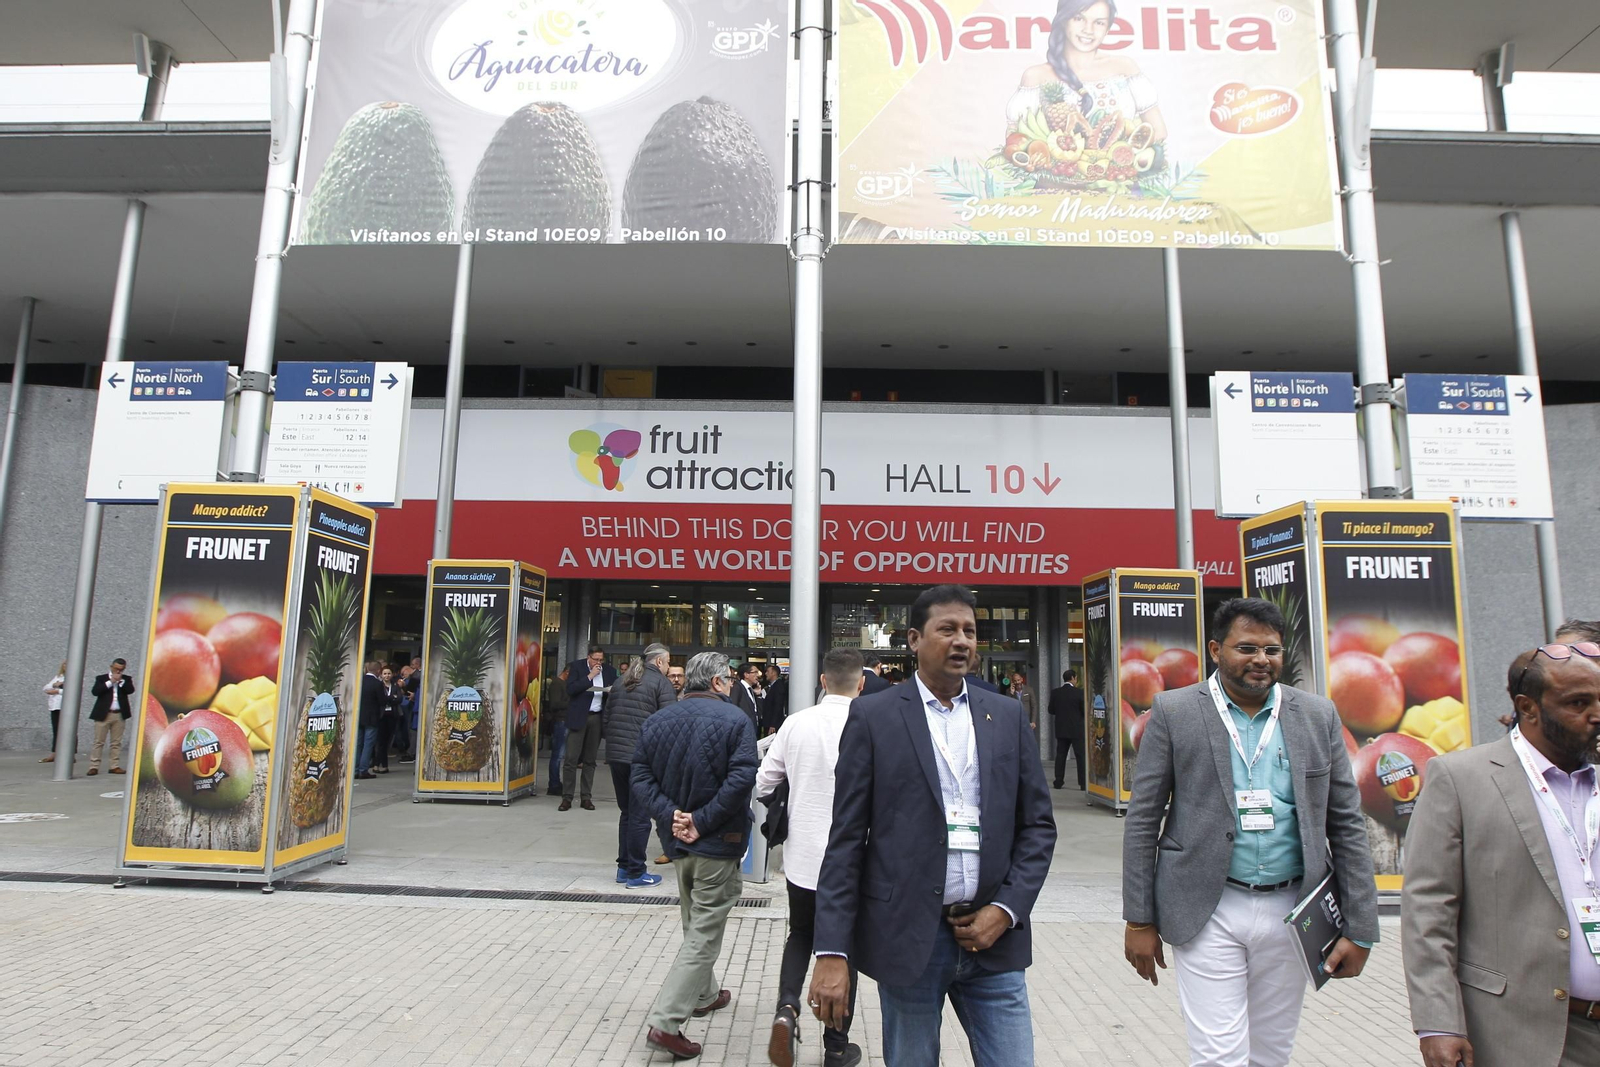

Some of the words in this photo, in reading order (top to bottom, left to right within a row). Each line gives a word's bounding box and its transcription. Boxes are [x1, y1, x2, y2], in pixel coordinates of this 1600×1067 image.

[858, 0, 1277, 66] Marelita
[449, 40, 648, 92] Aguacatera
[518, 81, 542, 91] DEL
[550, 81, 578, 91] SUR
[960, 196, 1042, 222] Somos
[1051, 196, 1212, 224] Maduradores
[351, 228, 431, 243] Visítanos
[436, 231, 458, 243] en
[464, 228, 480, 243] el
[485, 228, 538, 243] Stand
[544, 228, 601, 242] 10E09
[621, 226, 700, 242] Pabellón
[705, 227, 727, 242] 10
[897, 226, 981, 242] Visítanos
[986, 230, 1009, 242] en
[1015, 227, 1031, 242] el
[1037, 228, 1090, 243] Stand
[1097, 229, 1154, 244] 10E09
[1173, 229, 1256, 245] Pabellón
[1259, 231, 1279, 246] 10
[135, 373, 167, 383] Norte
[174, 372, 203, 383] North
[312, 374, 332, 384] Sur
[339, 373, 371, 384] South
[1254, 384, 1289, 394] Norte
[1296, 384, 1329, 395] North
[1442, 387, 1465, 397] Sur
[1471, 387, 1505, 398] South
[650, 424, 722, 454] fruit
[646, 460, 836, 491] attractin
[886, 464, 971, 494] HALL
[985, 464, 1025, 495] 10
[193, 503, 229, 519] Mango
[230, 505, 269, 518] addict?
[318, 512, 348, 531] Pineapples
[347, 521, 366, 537] addict?
[582, 516, 680, 538] BEHIND
[688, 517, 743, 539] THIS
[753, 518, 839, 541] DOR
[847, 519, 907, 542] YOU
[916, 520, 975, 543] WILL
[983, 521, 1046, 544] FIND
[1342, 522, 1352, 534] Ti
[1353, 522, 1382, 537] piace
[1383, 522, 1391, 534] il
[1391, 522, 1435, 537] mango?
[186, 537, 270, 561] FRUNET
[317, 545, 360, 575] FRUNET
[558, 547, 579, 567] A
[585, 548, 685, 569] WHOLE
[854, 551, 1070, 574] OPPORTUNITIES
[1196, 561, 1236, 575] HALL
[1346, 556, 1432, 579] FRUNET
[445, 573, 469, 581] Ananas
[469, 573, 496, 582] süchtig?
[1255, 560, 1295, 588] FRUNET
[1133, 581, 1156, 591] Mango
[1156, 582, 1181, 591] addict?
[445, 593, 497, 608] FRUNET
[523, 596, 540, 612] FRUNET
[1088, 603, 1106, 620] FRUNET
[1132, 602, 1184, 617] FRUNET
[448, 701, 481, 711] FRUNET
[307, 716, 336, 732] FRUNET
[186, 742, 219, 760] FRUNET
[1381, 766, 1415, 785] FRUNET
